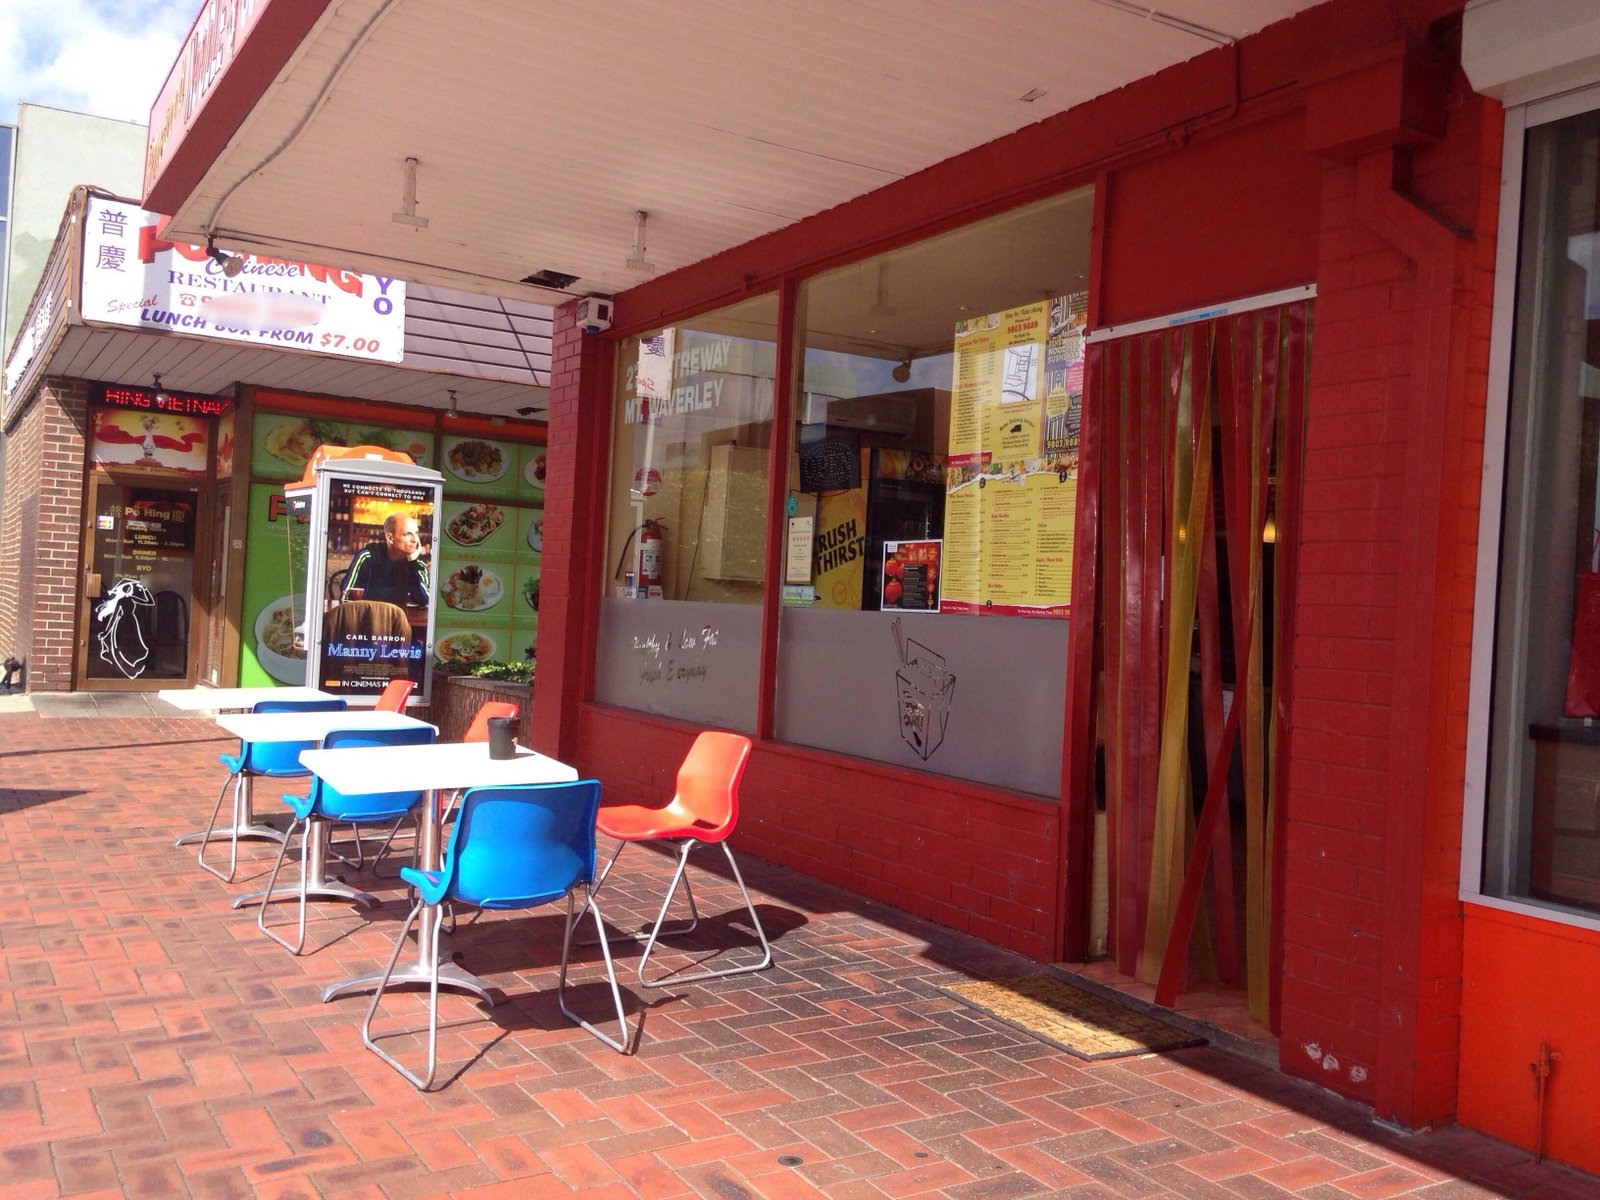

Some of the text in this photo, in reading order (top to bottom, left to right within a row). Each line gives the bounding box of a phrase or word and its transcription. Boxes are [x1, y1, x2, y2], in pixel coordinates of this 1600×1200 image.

[205, 256, 299, 278] Cinese
[106, 294, 158, 314] Special
[140, 307, 207, 329] LUNCH
[319, 332, 381, 354] $7.00
[648, 379, 725, 419] WAVERLEY
[124, 506, 140, 518] Po
[143, 508, 170, 521] Hing
[327, 643, 422, 662] Manny Lewis
